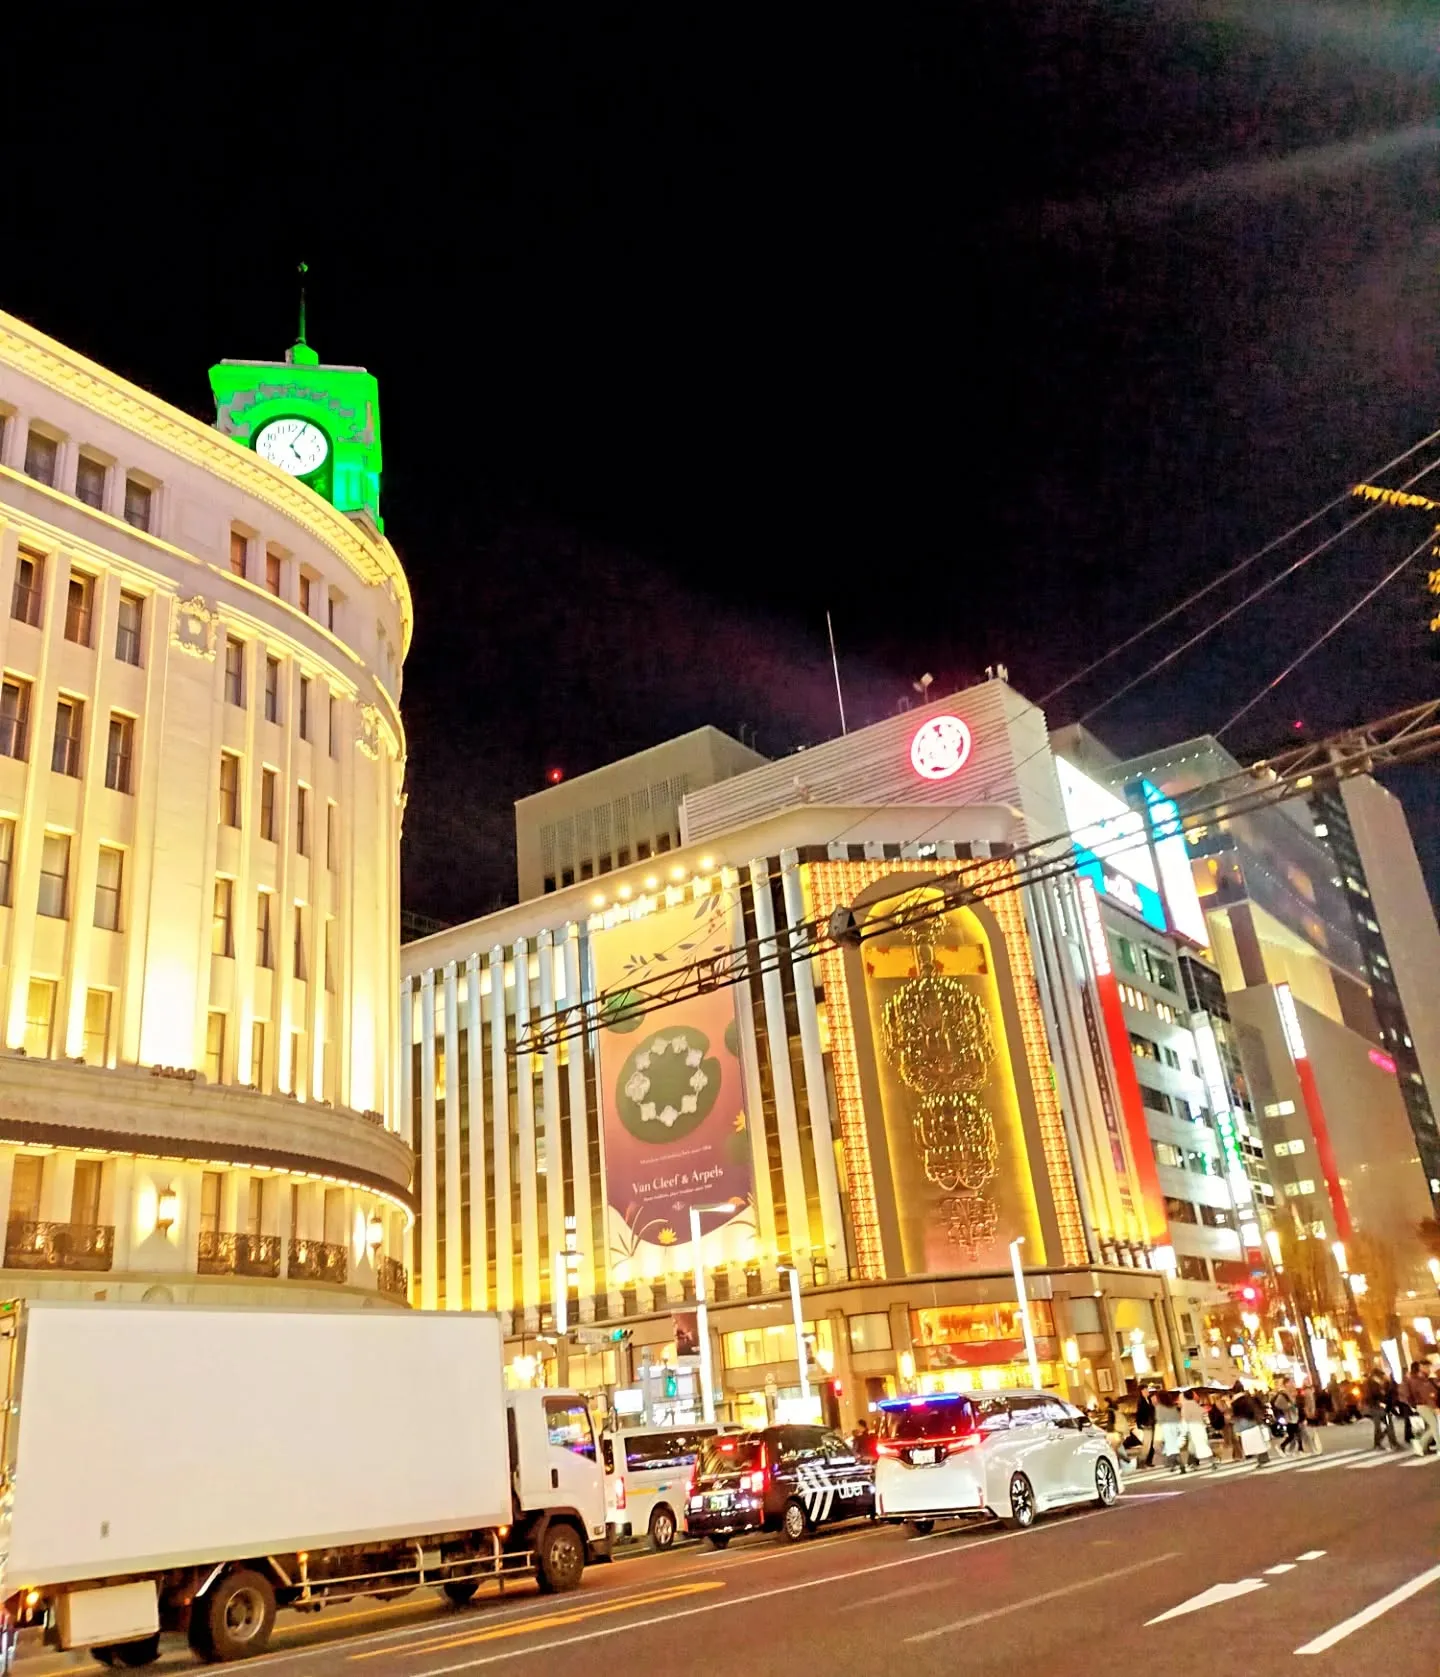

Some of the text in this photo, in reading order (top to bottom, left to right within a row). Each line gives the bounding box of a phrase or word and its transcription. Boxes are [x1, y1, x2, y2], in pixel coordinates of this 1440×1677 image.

[277, 425, 285, 435] 11
[287, 423, 298, 433] 12
[267, 432, 277, 441] 10
[631, 1180, 651, 1195] Van
[652, 1172, 681, 1191] Cleef
[680, 1174, 690, 1185] &
[690, 1164, 724, 1184] Arpels
[837, 1481, 864, 1500] Uber
